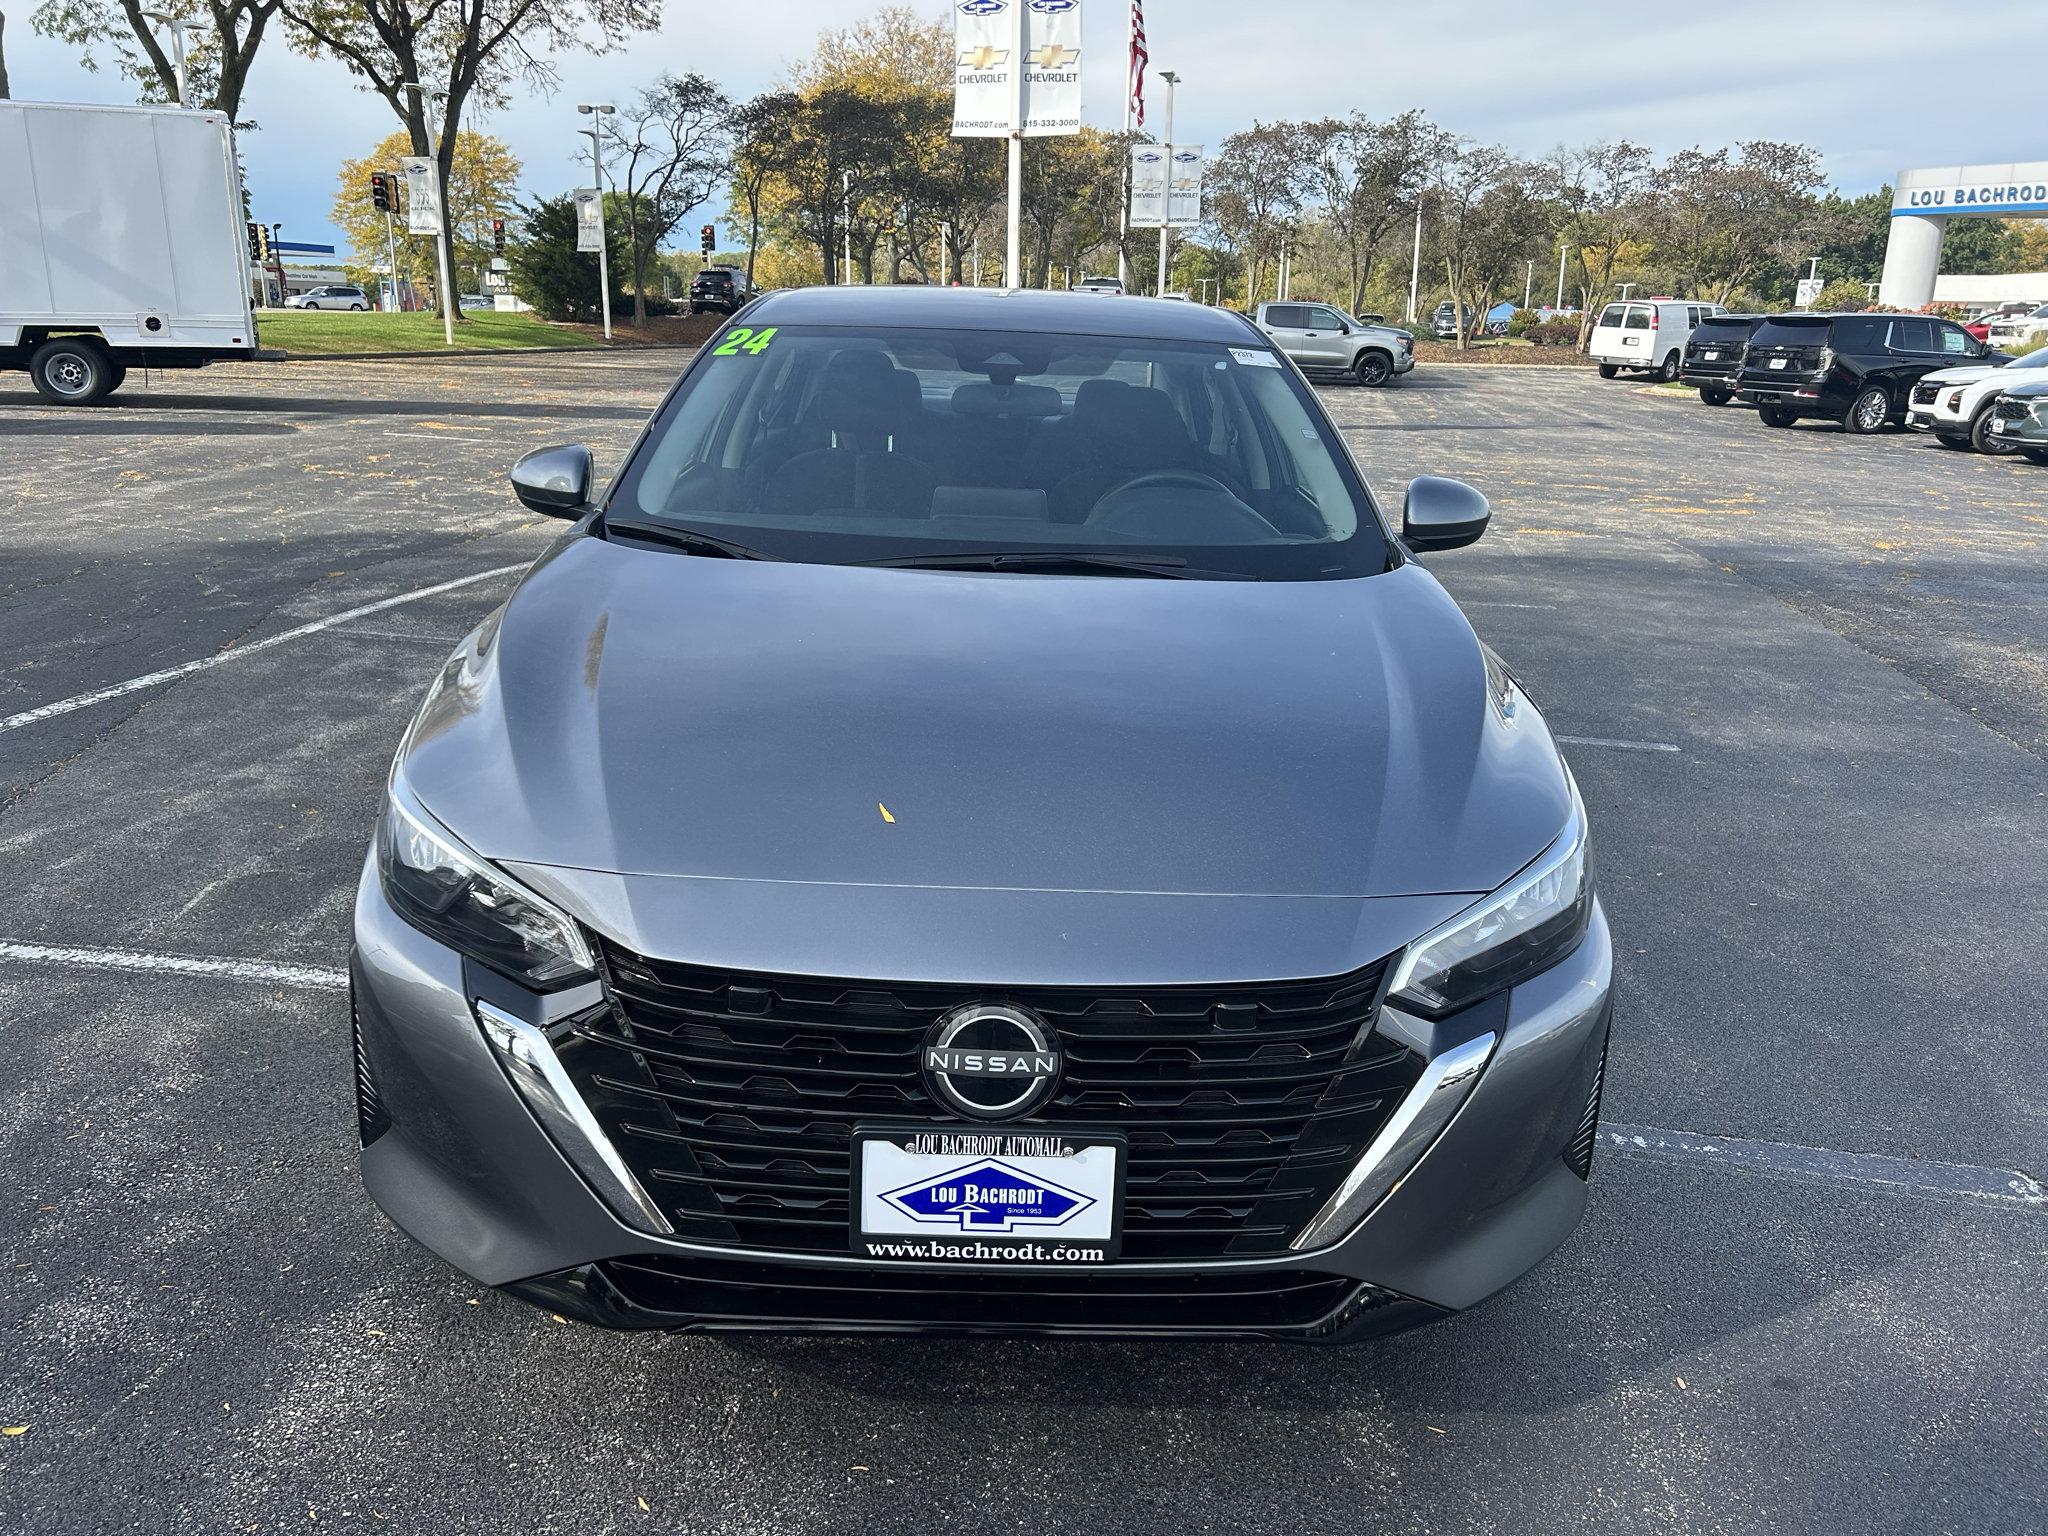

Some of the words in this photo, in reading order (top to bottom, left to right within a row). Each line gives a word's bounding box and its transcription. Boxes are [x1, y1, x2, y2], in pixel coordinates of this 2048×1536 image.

[959, 73, 1008, 84] CHEVROLET
[1024, 72, 1078, 82] CHEVROLET
[1023, 119, 1079, 127] 815-332-3000
[1910, 190, 1945, 206] LOU
[1954, 185, 2047, 204] BACHROD
[712, 328, 778, 355] 24
[930, 1052, 1054, 1072] NISSAN
[915, 1134, 939, 1155] LOU
[941, 1135, 1003, 1156] BACHRODT
[1004, 1137, 1064, 1157] AUTOMALL
[931, 1187, 957, 1203] LOU
[866, 1240, 1104, 1261] www.bachrodt.com
